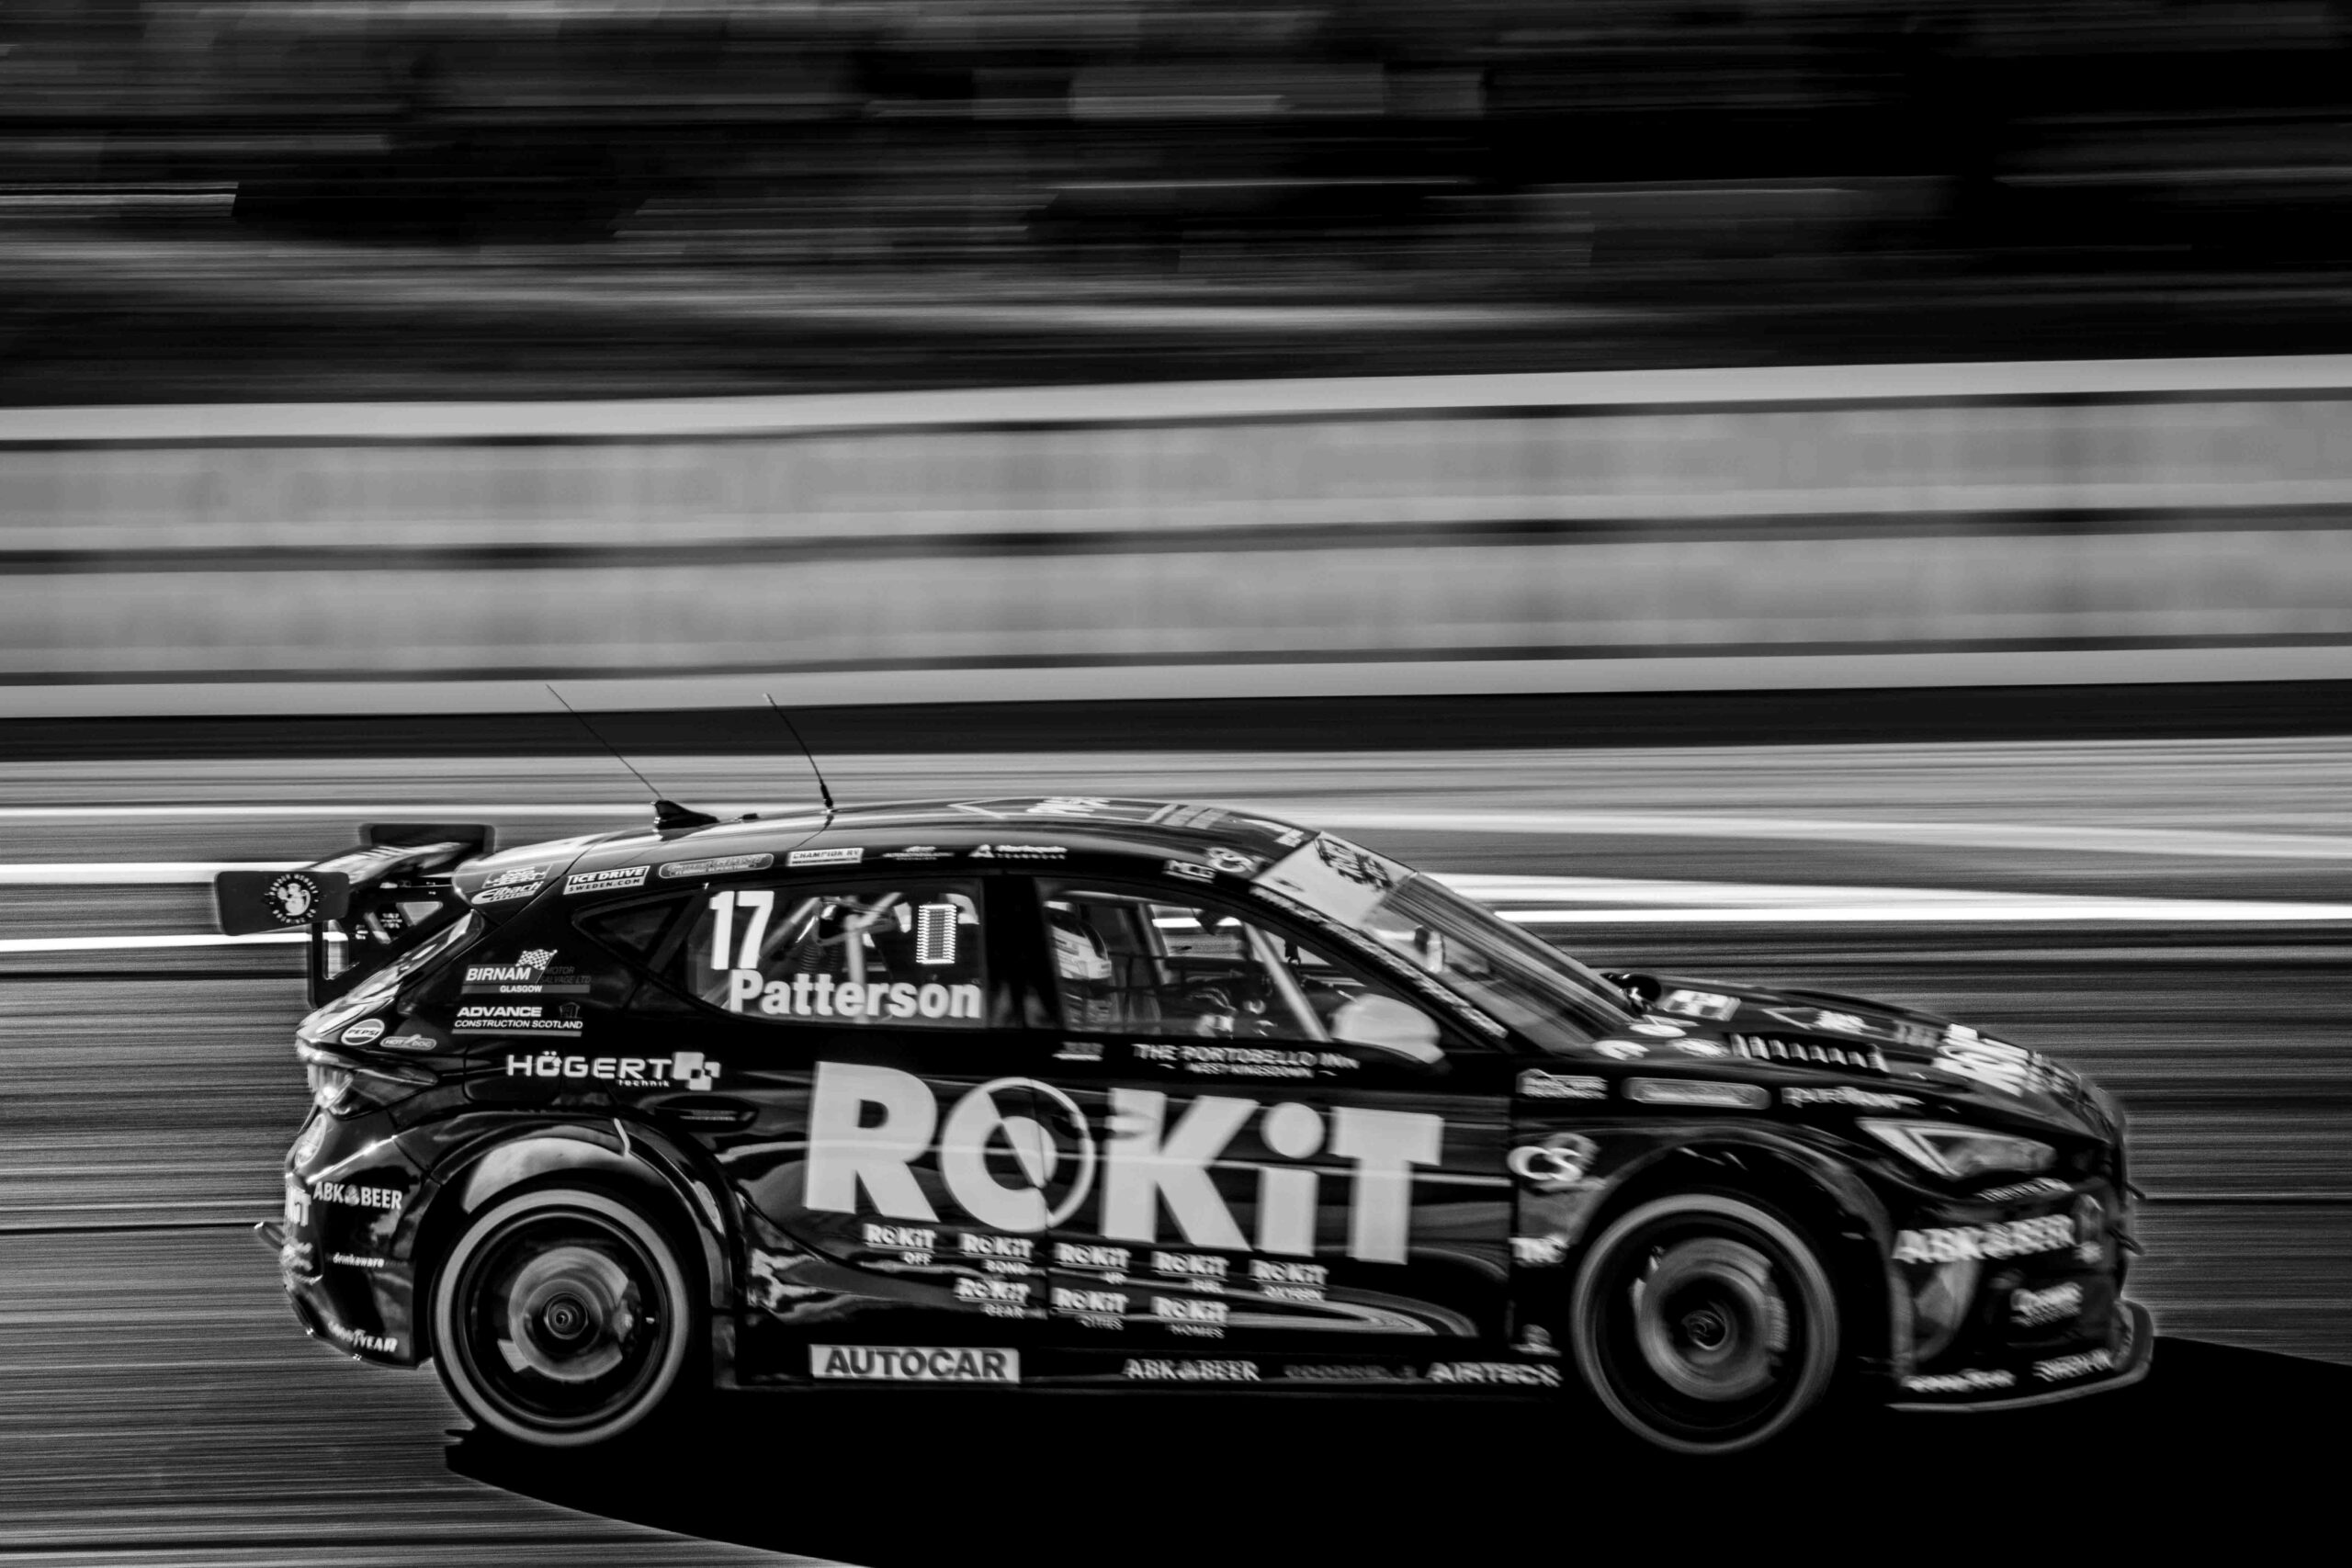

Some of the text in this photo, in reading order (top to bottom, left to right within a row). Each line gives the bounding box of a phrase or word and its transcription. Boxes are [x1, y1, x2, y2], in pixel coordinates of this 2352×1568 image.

[571, 868, 644, 884] ICE DRIVE
[568, 878, 641, 892] SWEDEN.COM
[709, 891, 775, 970] 17
[466, 967, 531, 981] BIRNAM
[500, 985, 543, 993] GLASGOW
[729, 970, 982, 1019] Patterson
[456, 1007, 543, 1017] ADVANCE
[347, 1028, 380, 1036] PEPSI
[454, 1020, 583, 1030] CONSTRUCTION SCOTLAND
[1132, 1043, 1179, 1062] THE
[507, 1051, 673, 1080] HÖGERT
[617, 1079, 671, 1088] technik
[312, 1181, 403, 1211] ABK BEER
[824, 1347, 1008, 1379] AUTOCAR
[1122, 1359, 1178, 1379] ABK
